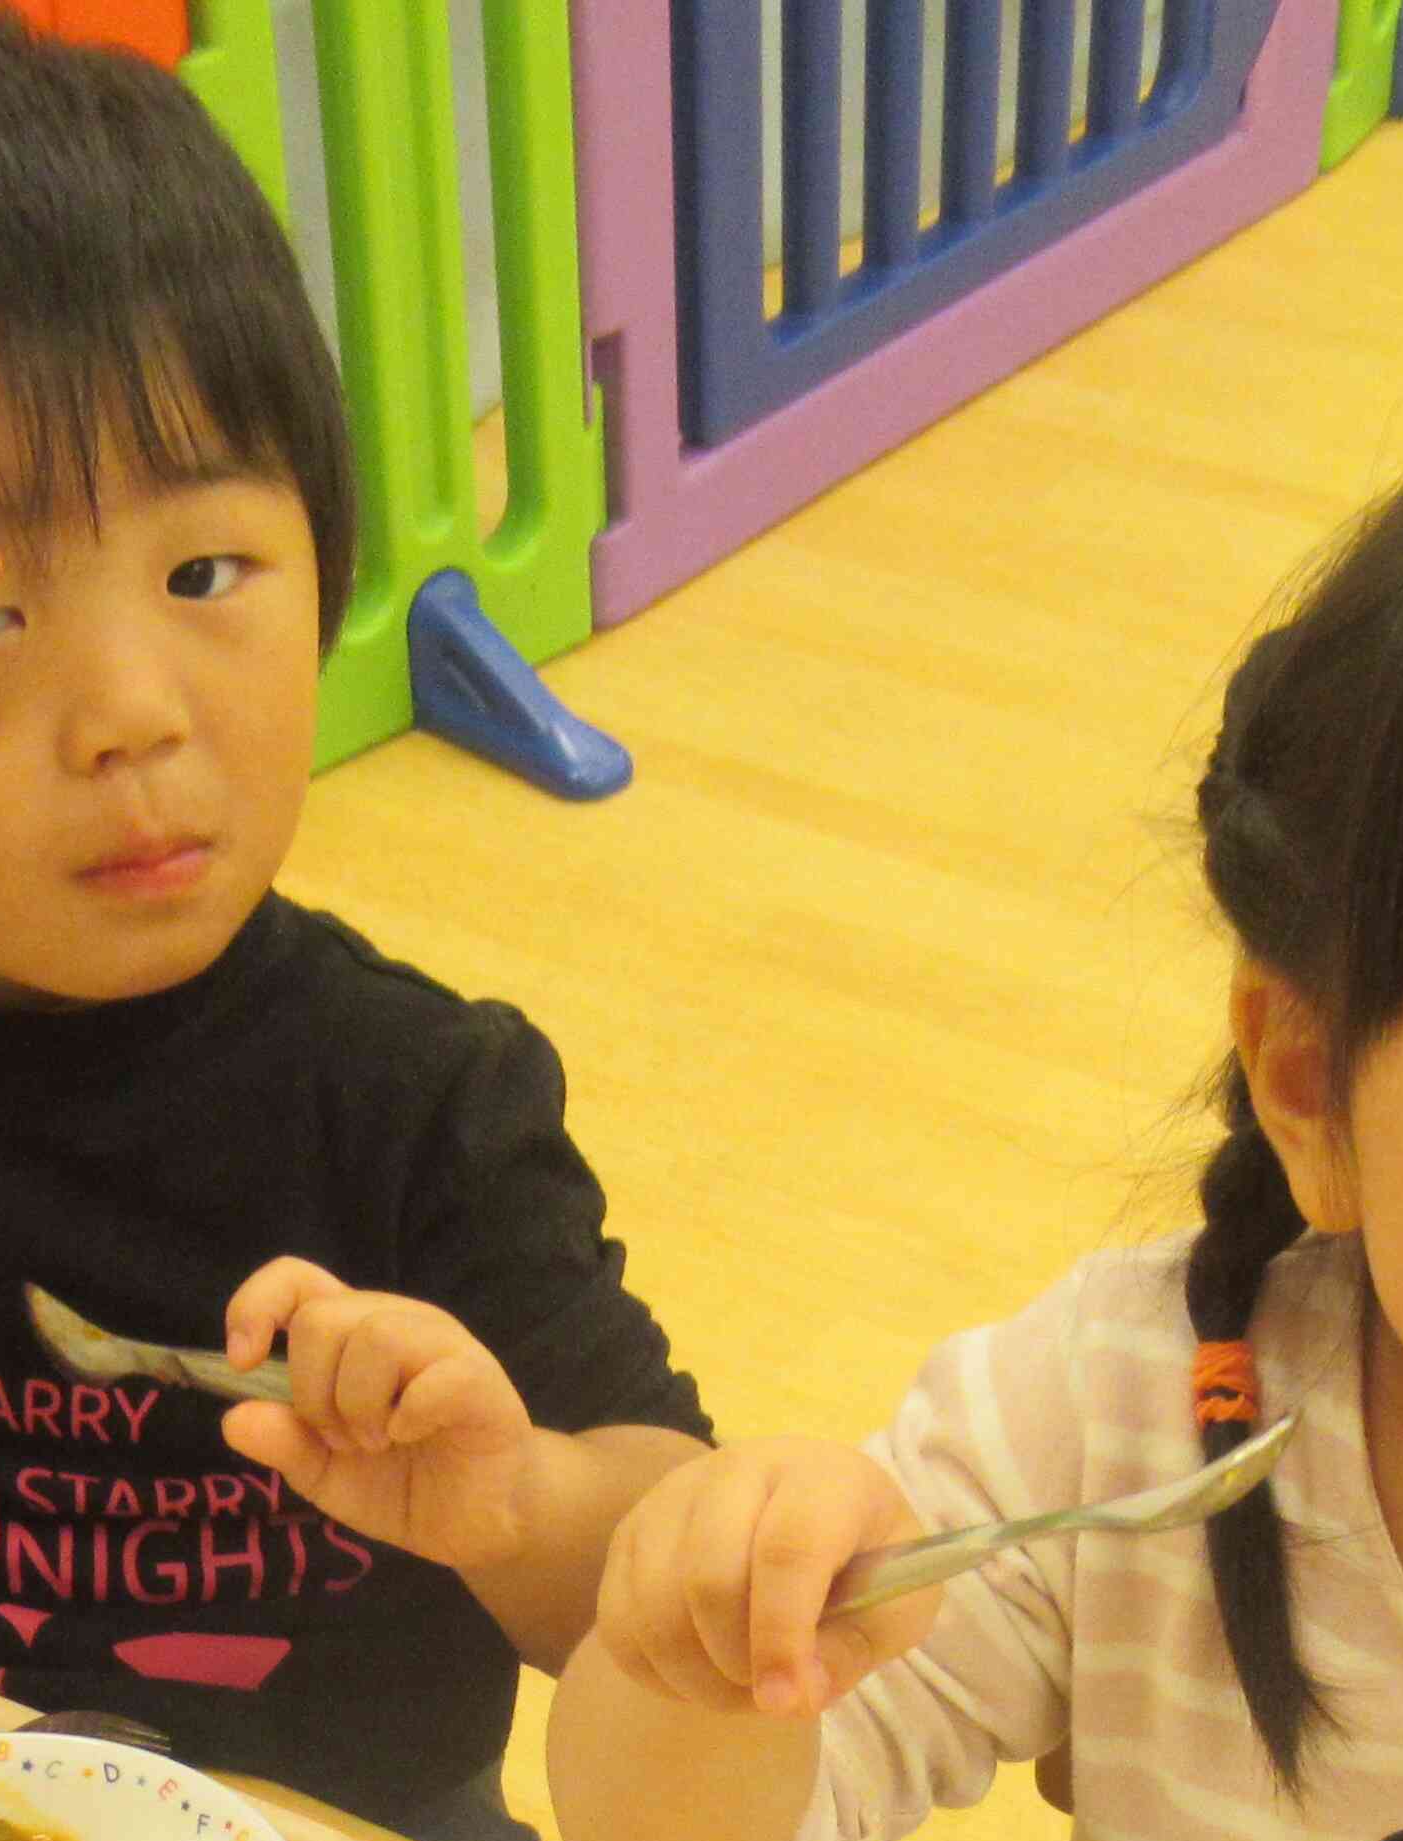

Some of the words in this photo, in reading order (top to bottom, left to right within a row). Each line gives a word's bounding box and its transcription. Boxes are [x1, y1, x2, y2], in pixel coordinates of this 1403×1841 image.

[6, 1515, 373, 1605] NIGHTS
[45, 1760, 62, 1779] C
[103, 1762, 120, 1784] D
[158, 1778, 180, 1800] E
[196, 1813, 212, 1835] F
